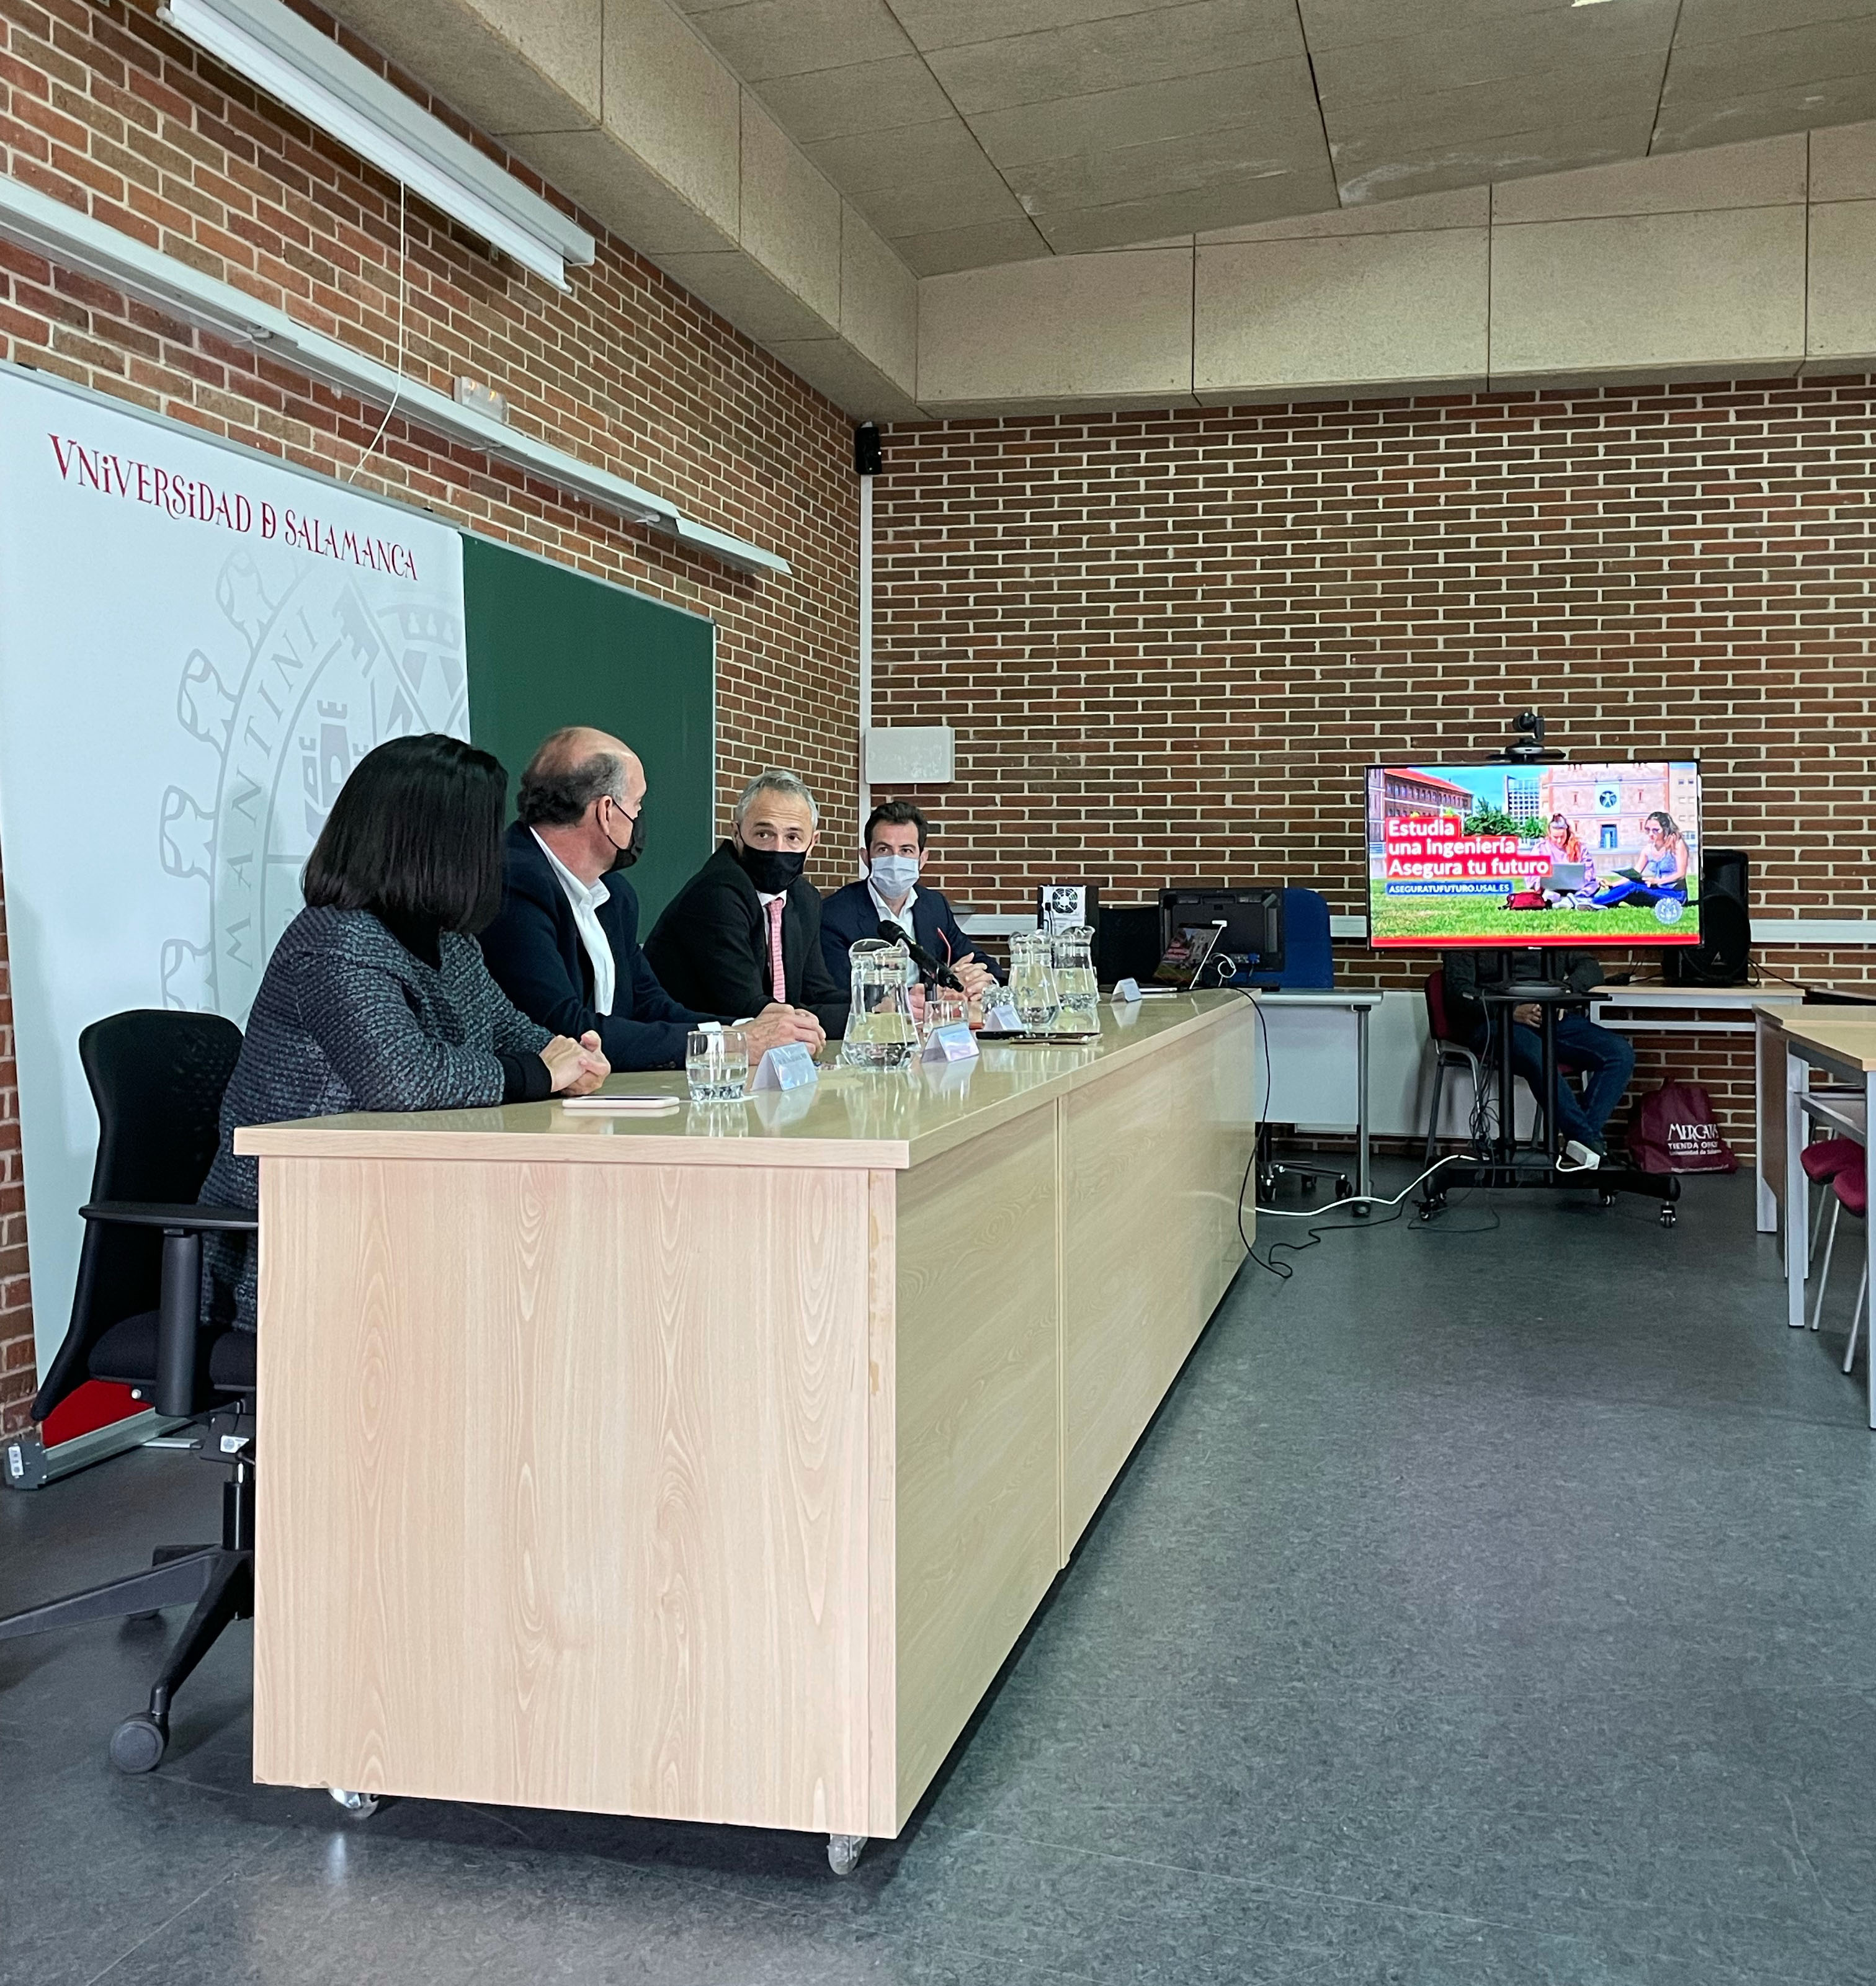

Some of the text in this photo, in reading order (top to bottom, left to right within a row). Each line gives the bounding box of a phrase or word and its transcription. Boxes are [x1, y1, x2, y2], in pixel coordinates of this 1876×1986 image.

[285, 509, 418, 581] SALAMANCA
[1388, 819, 1455, 836] Estudia
[1388, 837, 1516, 858] una ingeniería
[1388, 857, 1549, 879] Asegura tu futuro
